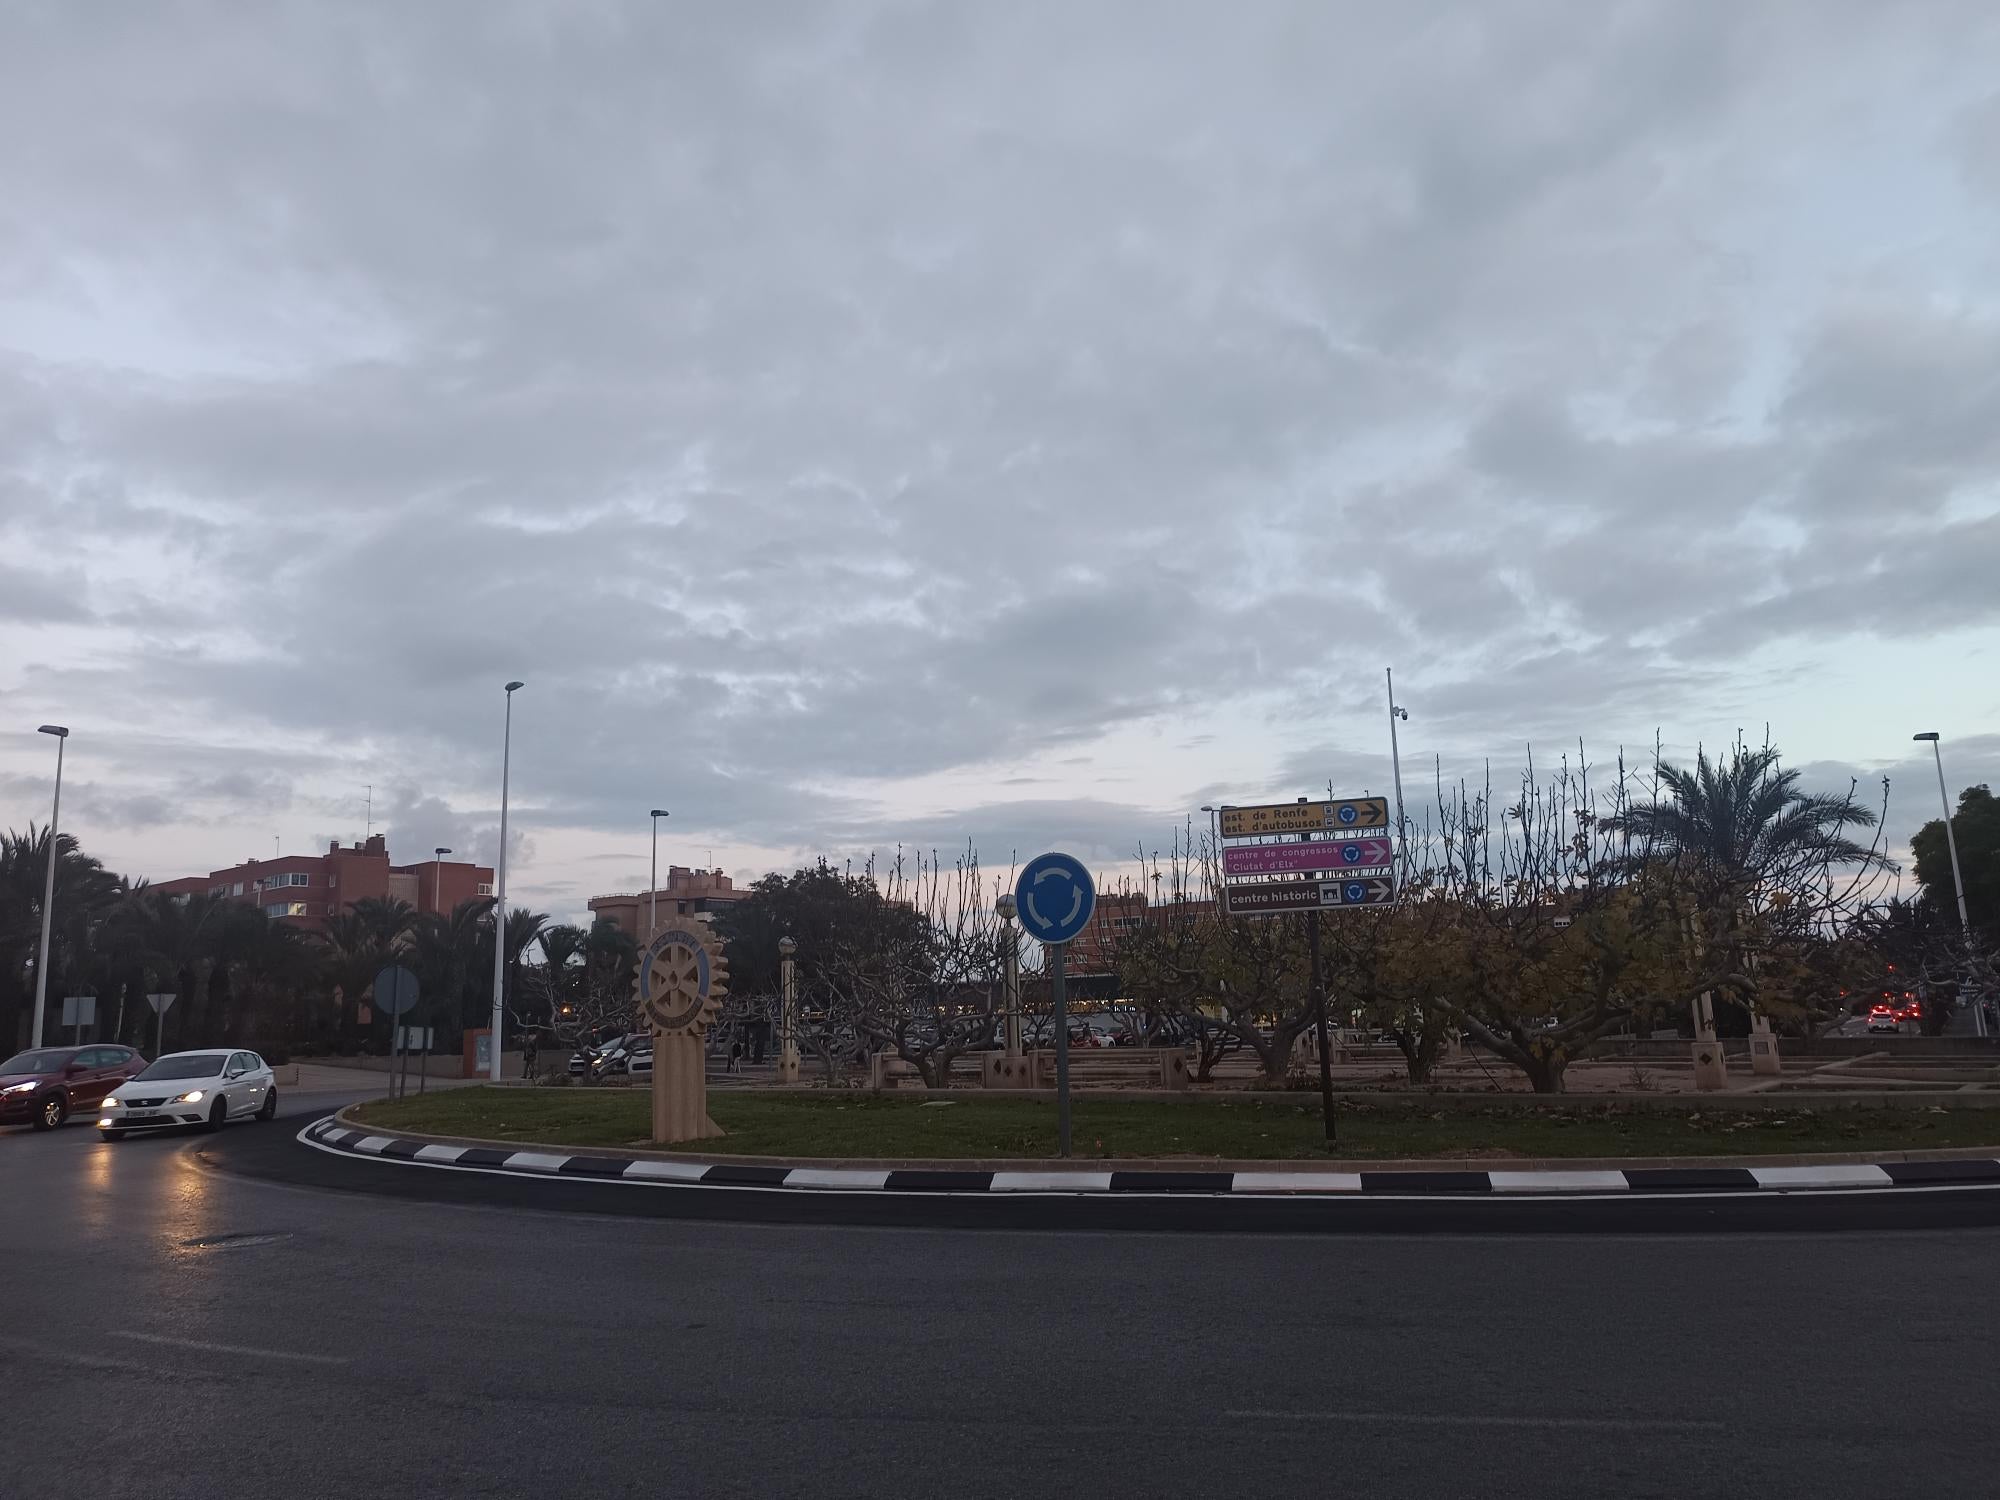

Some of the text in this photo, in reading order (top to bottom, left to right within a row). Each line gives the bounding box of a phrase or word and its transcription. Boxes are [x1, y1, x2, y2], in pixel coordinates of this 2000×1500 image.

[1225, 807, 1308, 822] est. de Renfe
[1225, 819, 1322, 833] est. d'autobusos
[1228, 846, 1338, 860] centre de congressos
[1231, 889, 1317, 904] centre històric
